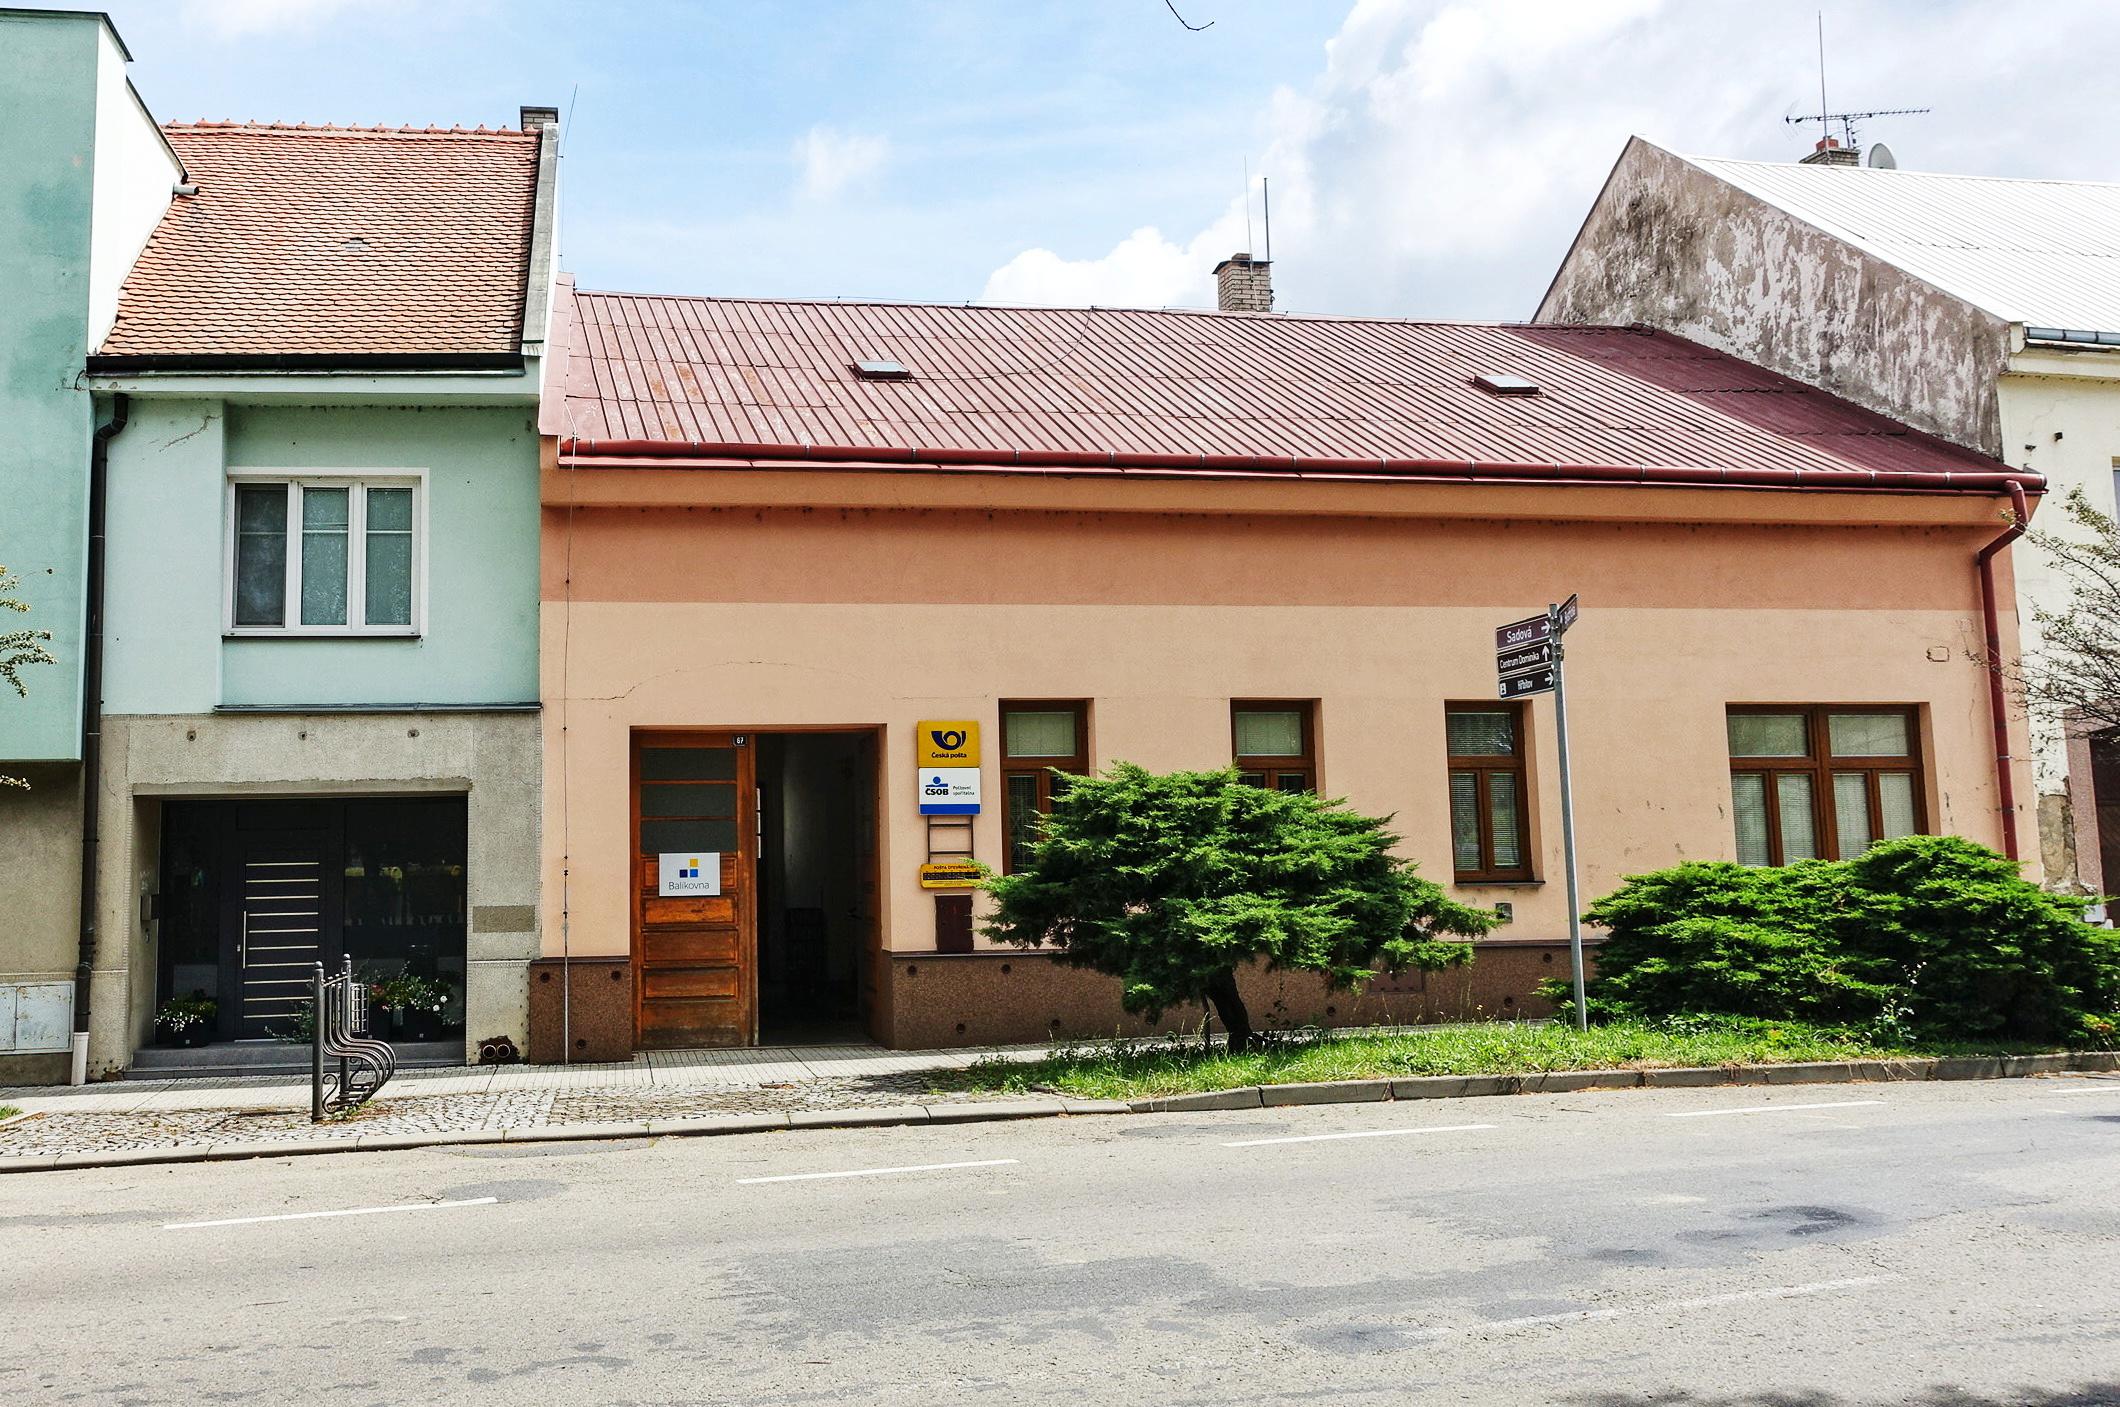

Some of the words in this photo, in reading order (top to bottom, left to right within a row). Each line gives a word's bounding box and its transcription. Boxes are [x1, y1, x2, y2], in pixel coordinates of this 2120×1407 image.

[1506, 626, 1532, 643] Sadová
[1500, 658, 1518, 669] Centrum
[1518, 652, 1540, 665] Dominika
[931, 751, 949, 759] Česká
[950, 751, 967, 759] pošta
[925, 787, 949, 796] ČSOB
[668, 881, 710, 891] Balíkovna
